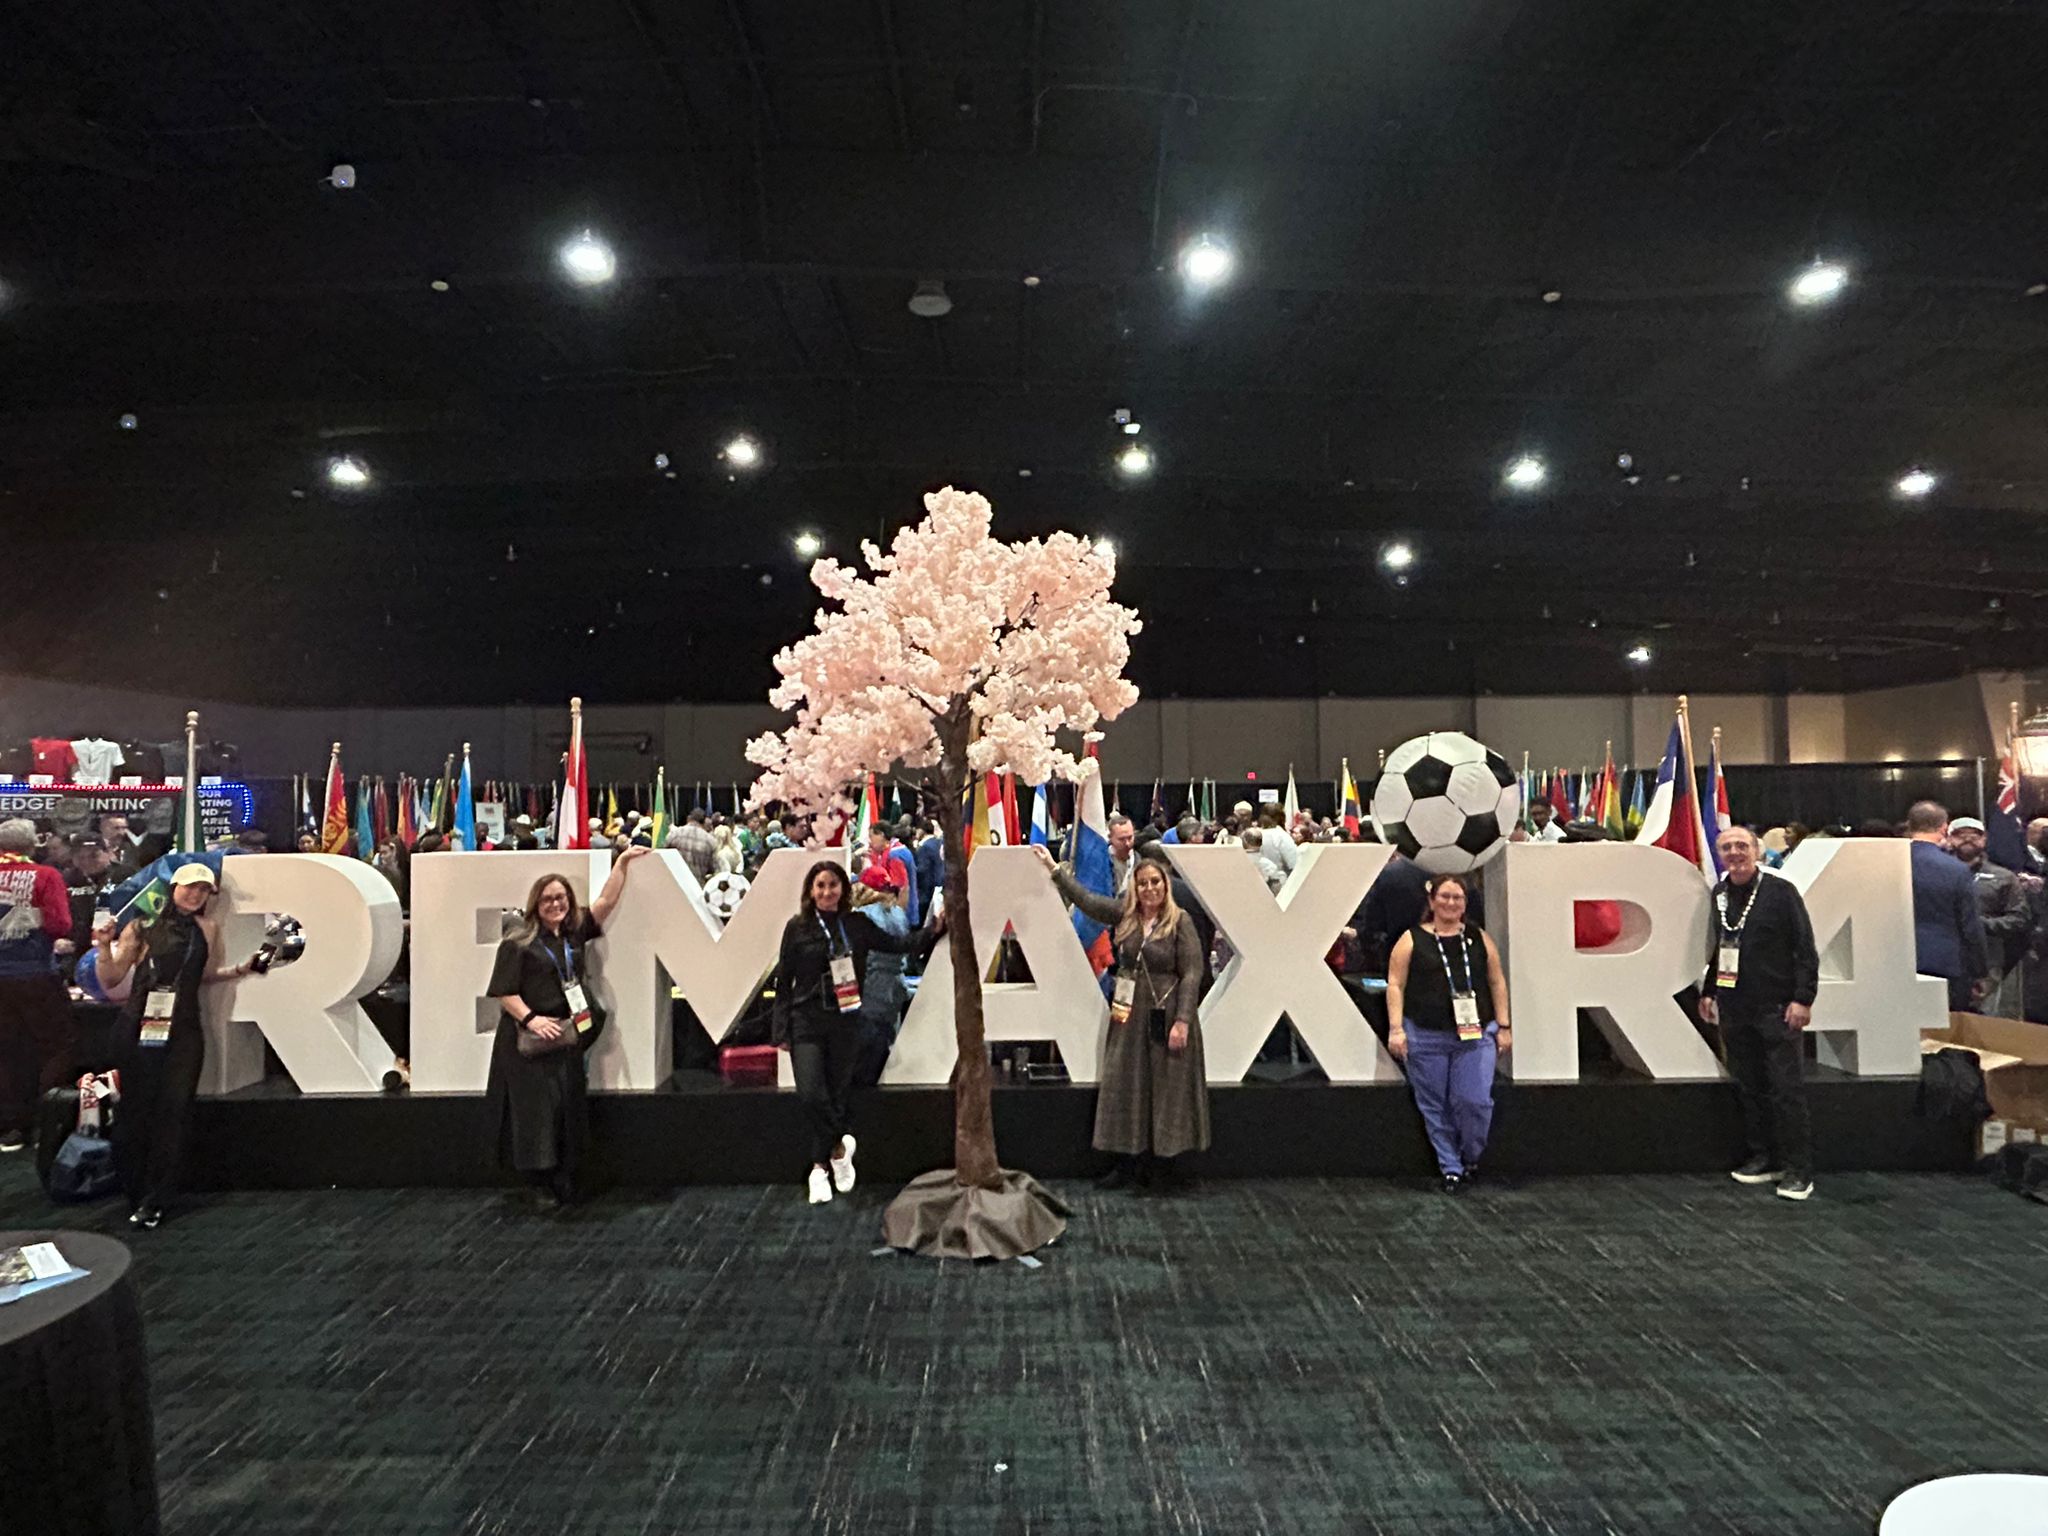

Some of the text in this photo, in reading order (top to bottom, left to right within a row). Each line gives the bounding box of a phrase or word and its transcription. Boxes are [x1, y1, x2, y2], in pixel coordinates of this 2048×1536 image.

[198, 790, 221, 798] OUR
[200, 799, 233, 807] NTING
[201, 808, 218, 816] ND
